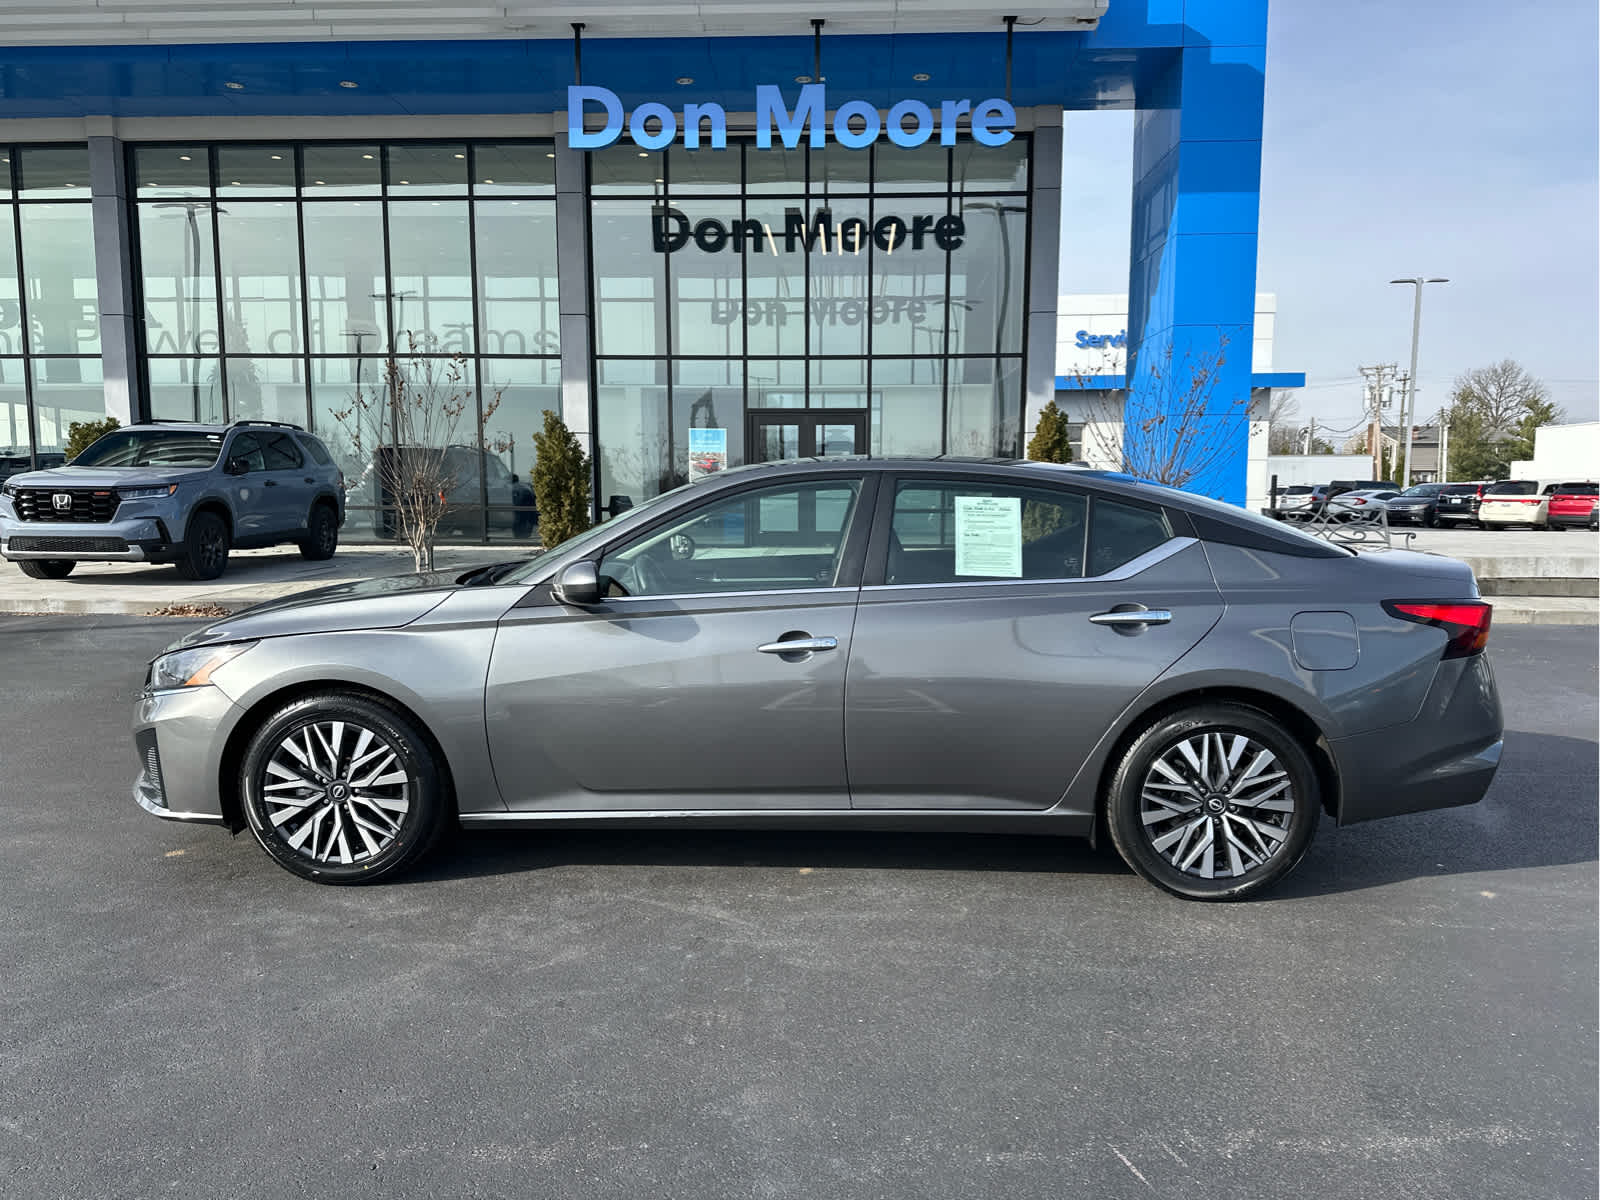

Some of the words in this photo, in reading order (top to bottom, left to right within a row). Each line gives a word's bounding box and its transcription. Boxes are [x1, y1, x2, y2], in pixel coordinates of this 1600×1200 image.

[567, 85, 727, 151] Don
[756, 83, 1016, 149] Moore
[652, 205, 763, 253] Don
[785, 206, 965, 253] Moore
[711, 297, 787, 326] Don
[1075, 329, 1128, 348] Servi
